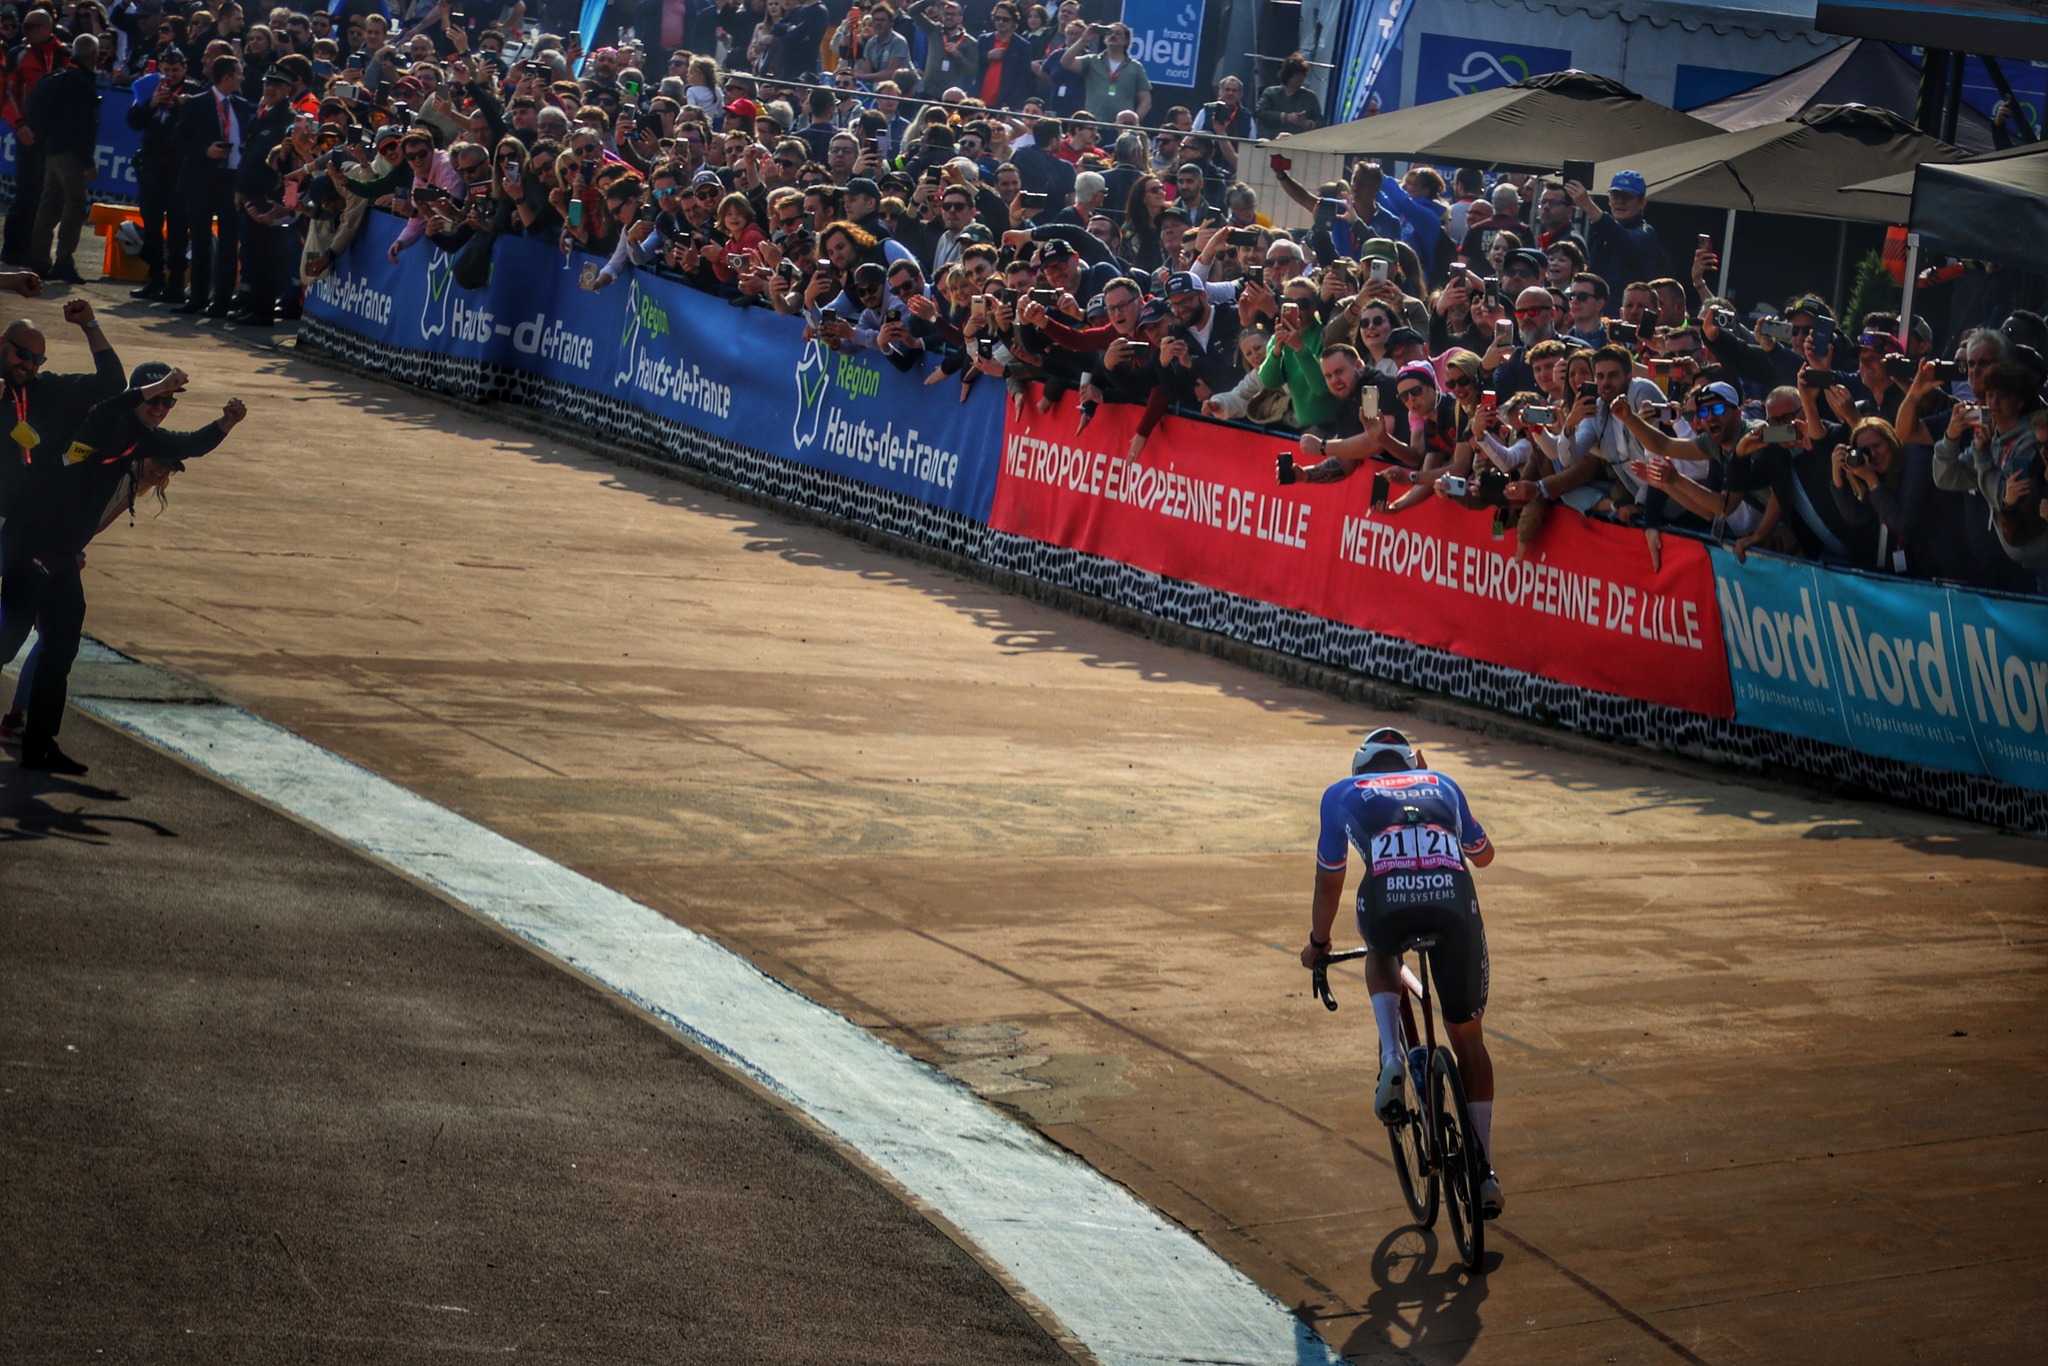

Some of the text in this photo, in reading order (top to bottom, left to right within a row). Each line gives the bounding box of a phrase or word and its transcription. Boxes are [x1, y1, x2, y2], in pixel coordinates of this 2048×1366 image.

[1129, 27, 1193, 67] bleu
[1163, 27, 1194, 41] france
[1166, 68, 1190, 79] nord
[641, 294, 671, 339] Région
[634, 345, 731, 419] Hauts-de-France
[836, 354, 881, 401] Région
[823, 406, 959, 490] Hauts-de-France
[1005, 426, 1312, 550] MÉTROPOLE EUROPÉENNE DE LILLE
[1340, 510, 1703, 650] MÉTROPOLE EUROPÉENNE DE LILLE
[1717, 575, 1830, 690] Nord
[1827, 600, 1959, 718] Nord
[1735, 683, 1745, 699] le
[1748, 686, 1802, 711] Département
[1802, 699, 1818, 714] est
[1851, 710, 1862, 727] le
[1864, 713, 1925, 736] Département
[1926, 724, 1943, 741] est
[1983, 734, 1994, 753] le
[1360, 785, 1443, 802] Elegant
[1379, 831, 1408, 859] 21
[1426, 830, 1454, 858] 21
[1372, 859, 1417, 872] lastminute
[1386, 873, 1454, 891] BRUSTOR
[1386, 889, 1456, 903] SUN SYSTEMS
